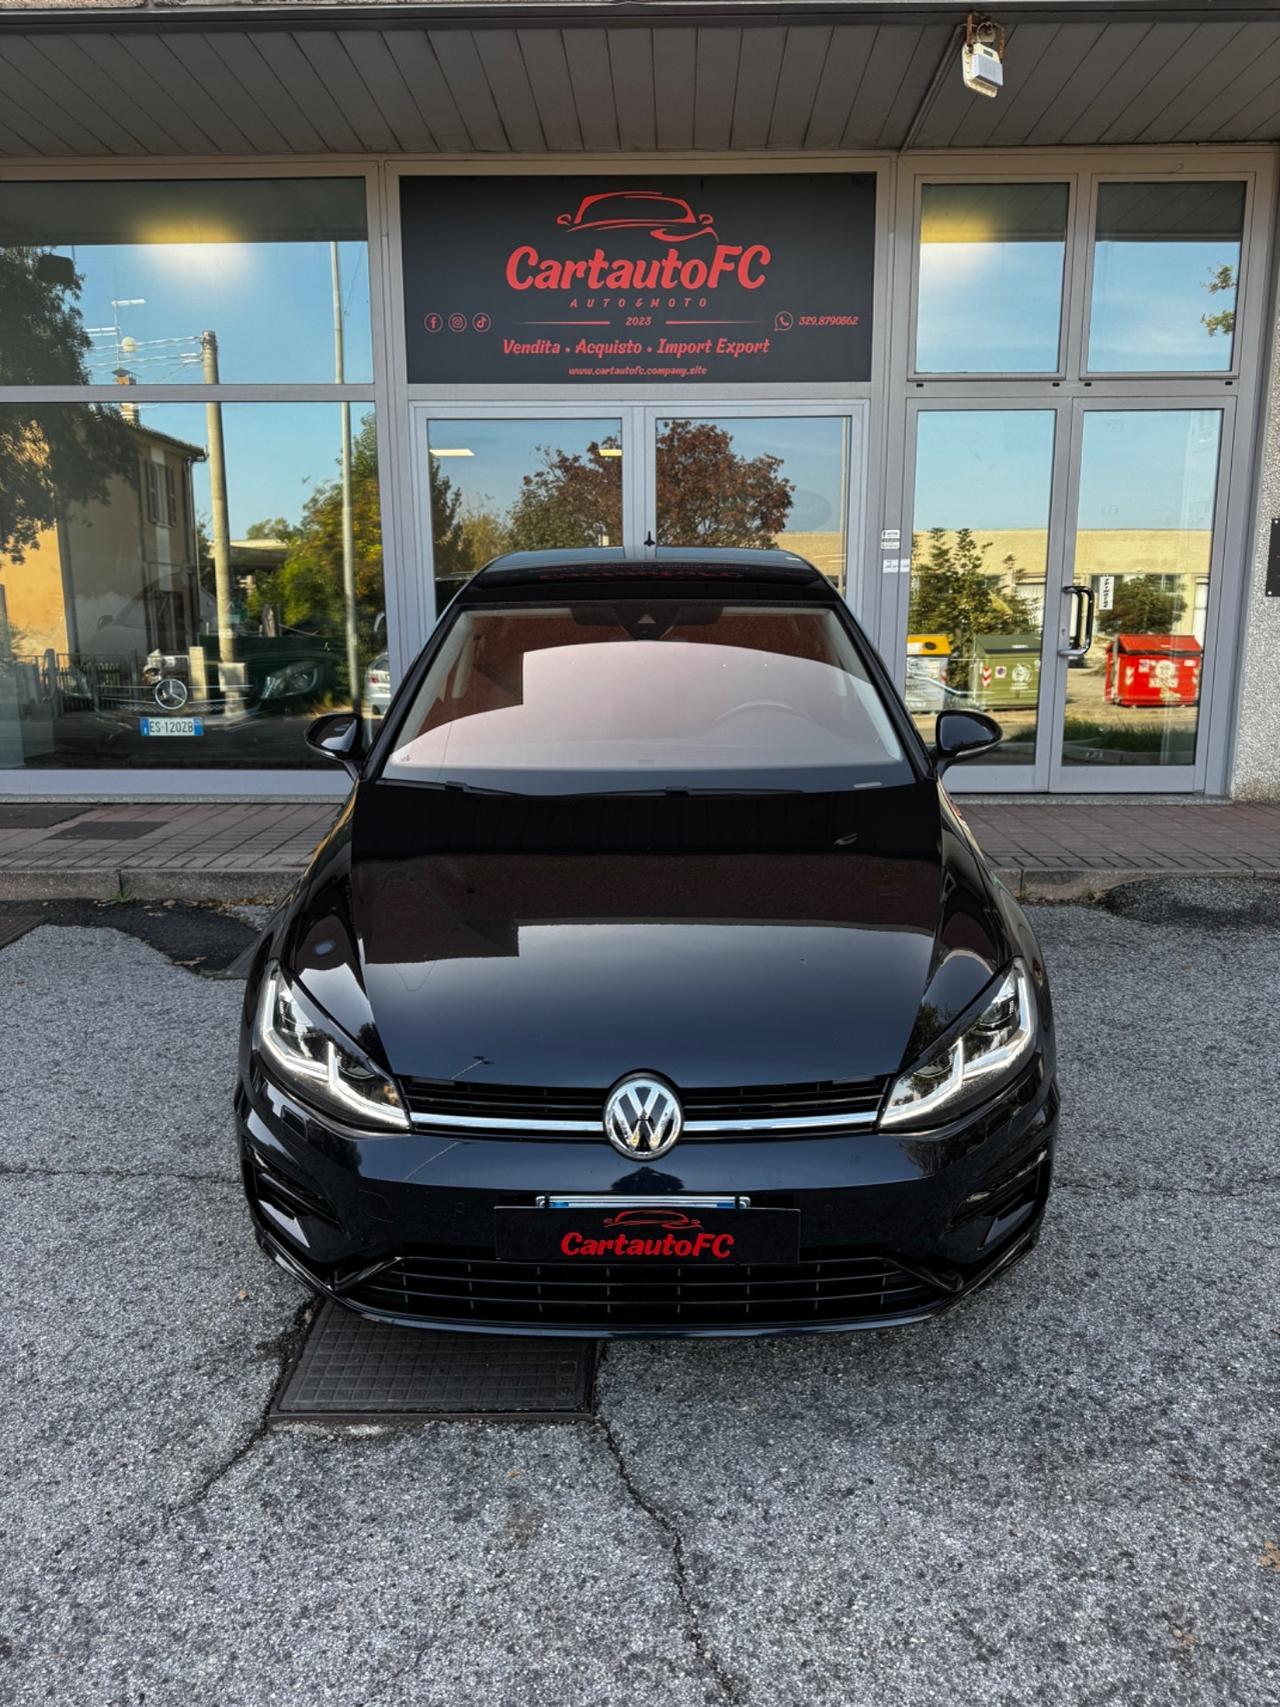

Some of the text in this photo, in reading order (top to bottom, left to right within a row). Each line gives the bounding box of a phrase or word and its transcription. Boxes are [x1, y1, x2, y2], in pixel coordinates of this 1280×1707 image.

[505, 244, 770, 291] CartautoFC
[624, 316, 652, 326] 2023
[502, 338, 771, 358] Vendita Acquisto Import Export
[568, 365, 708, 378] www.cartautofc.company.site
[560, 1231, 735, 1259] CartautoFC
